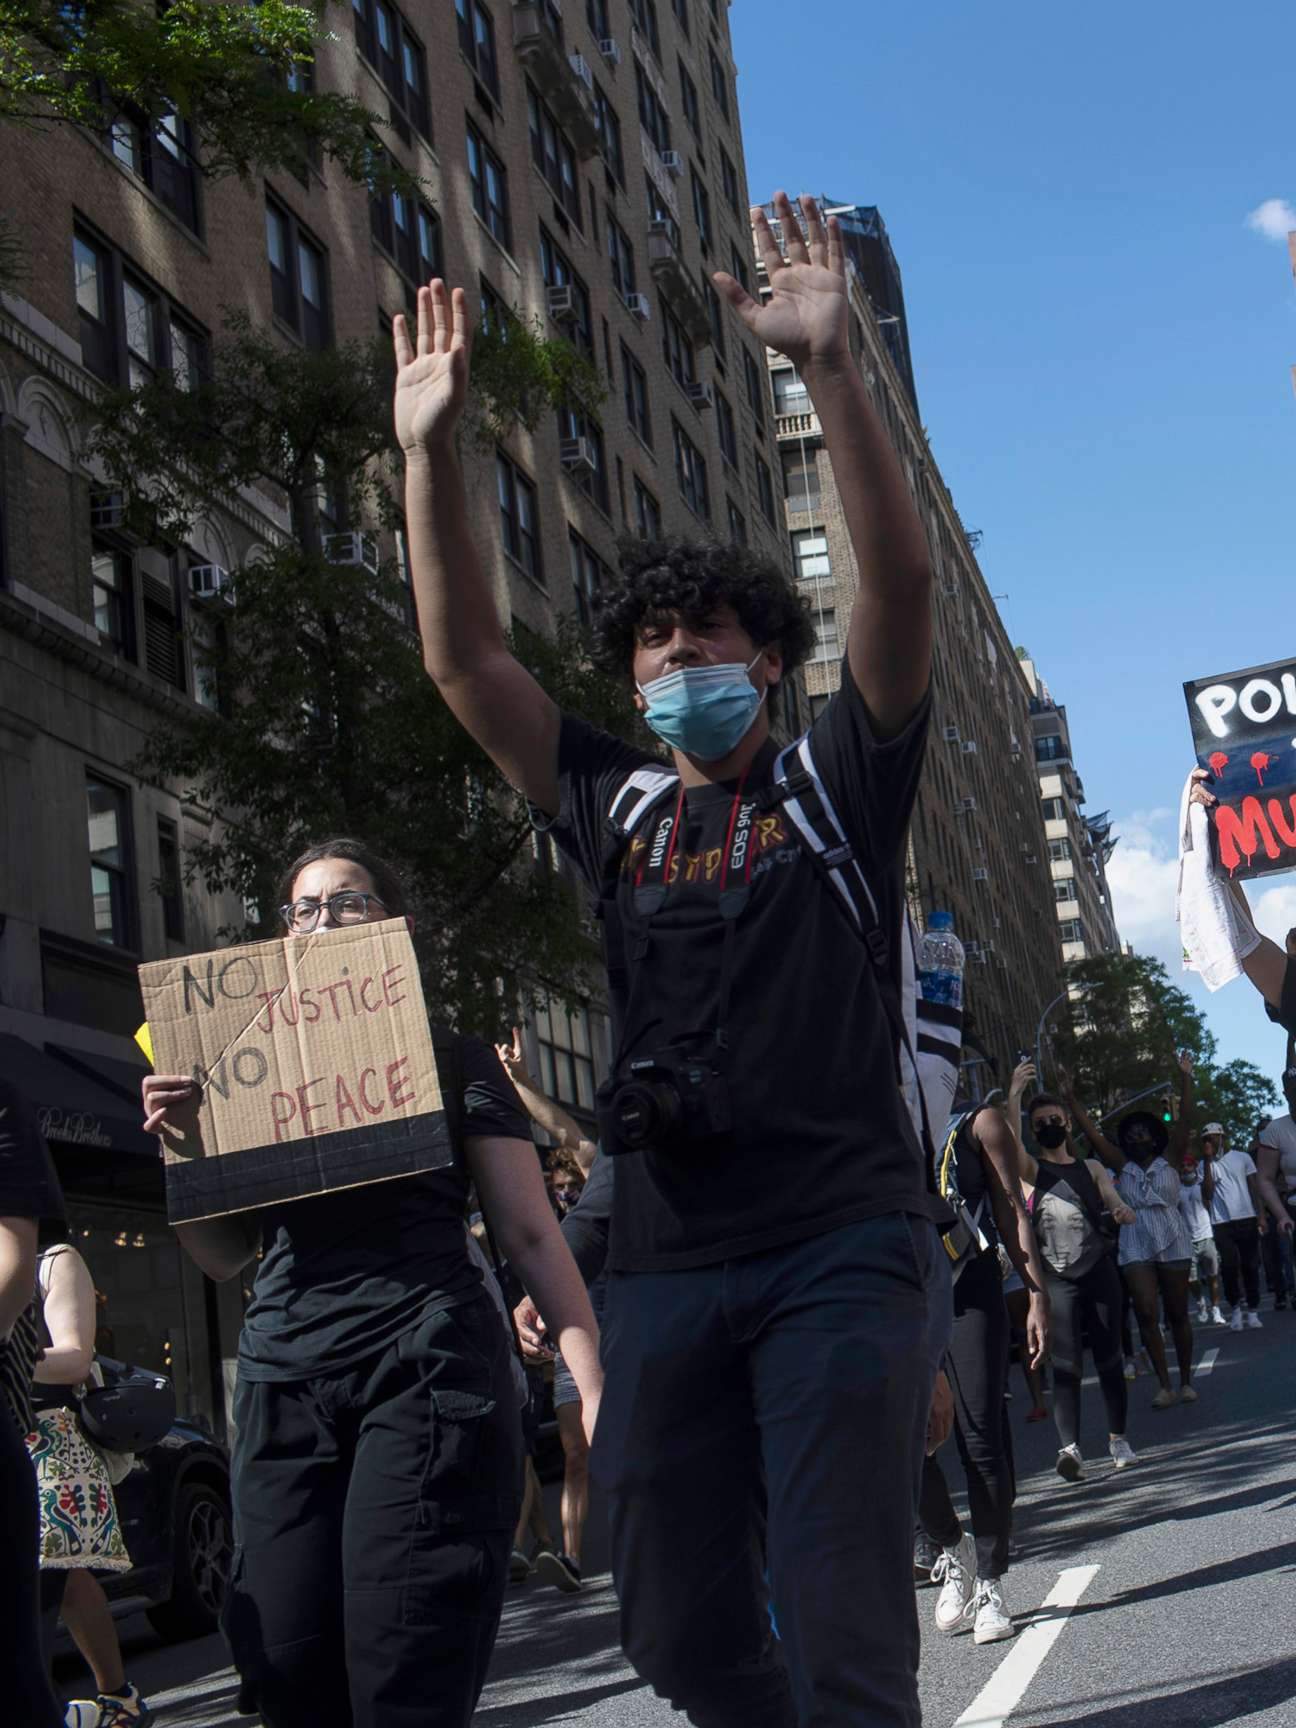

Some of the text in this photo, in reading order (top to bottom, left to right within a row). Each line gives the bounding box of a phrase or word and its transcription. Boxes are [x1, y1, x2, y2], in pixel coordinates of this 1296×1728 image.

[648, 816, 674, 868] Canon
[730, 829, 749, 869] EOS
[182, 957, 258, 1015] NO
[256, 964, 407, 1034] JUSTICE
[192, 1047, 268, 1107] NO
[271, 1056, 417, 1142] PEACE
